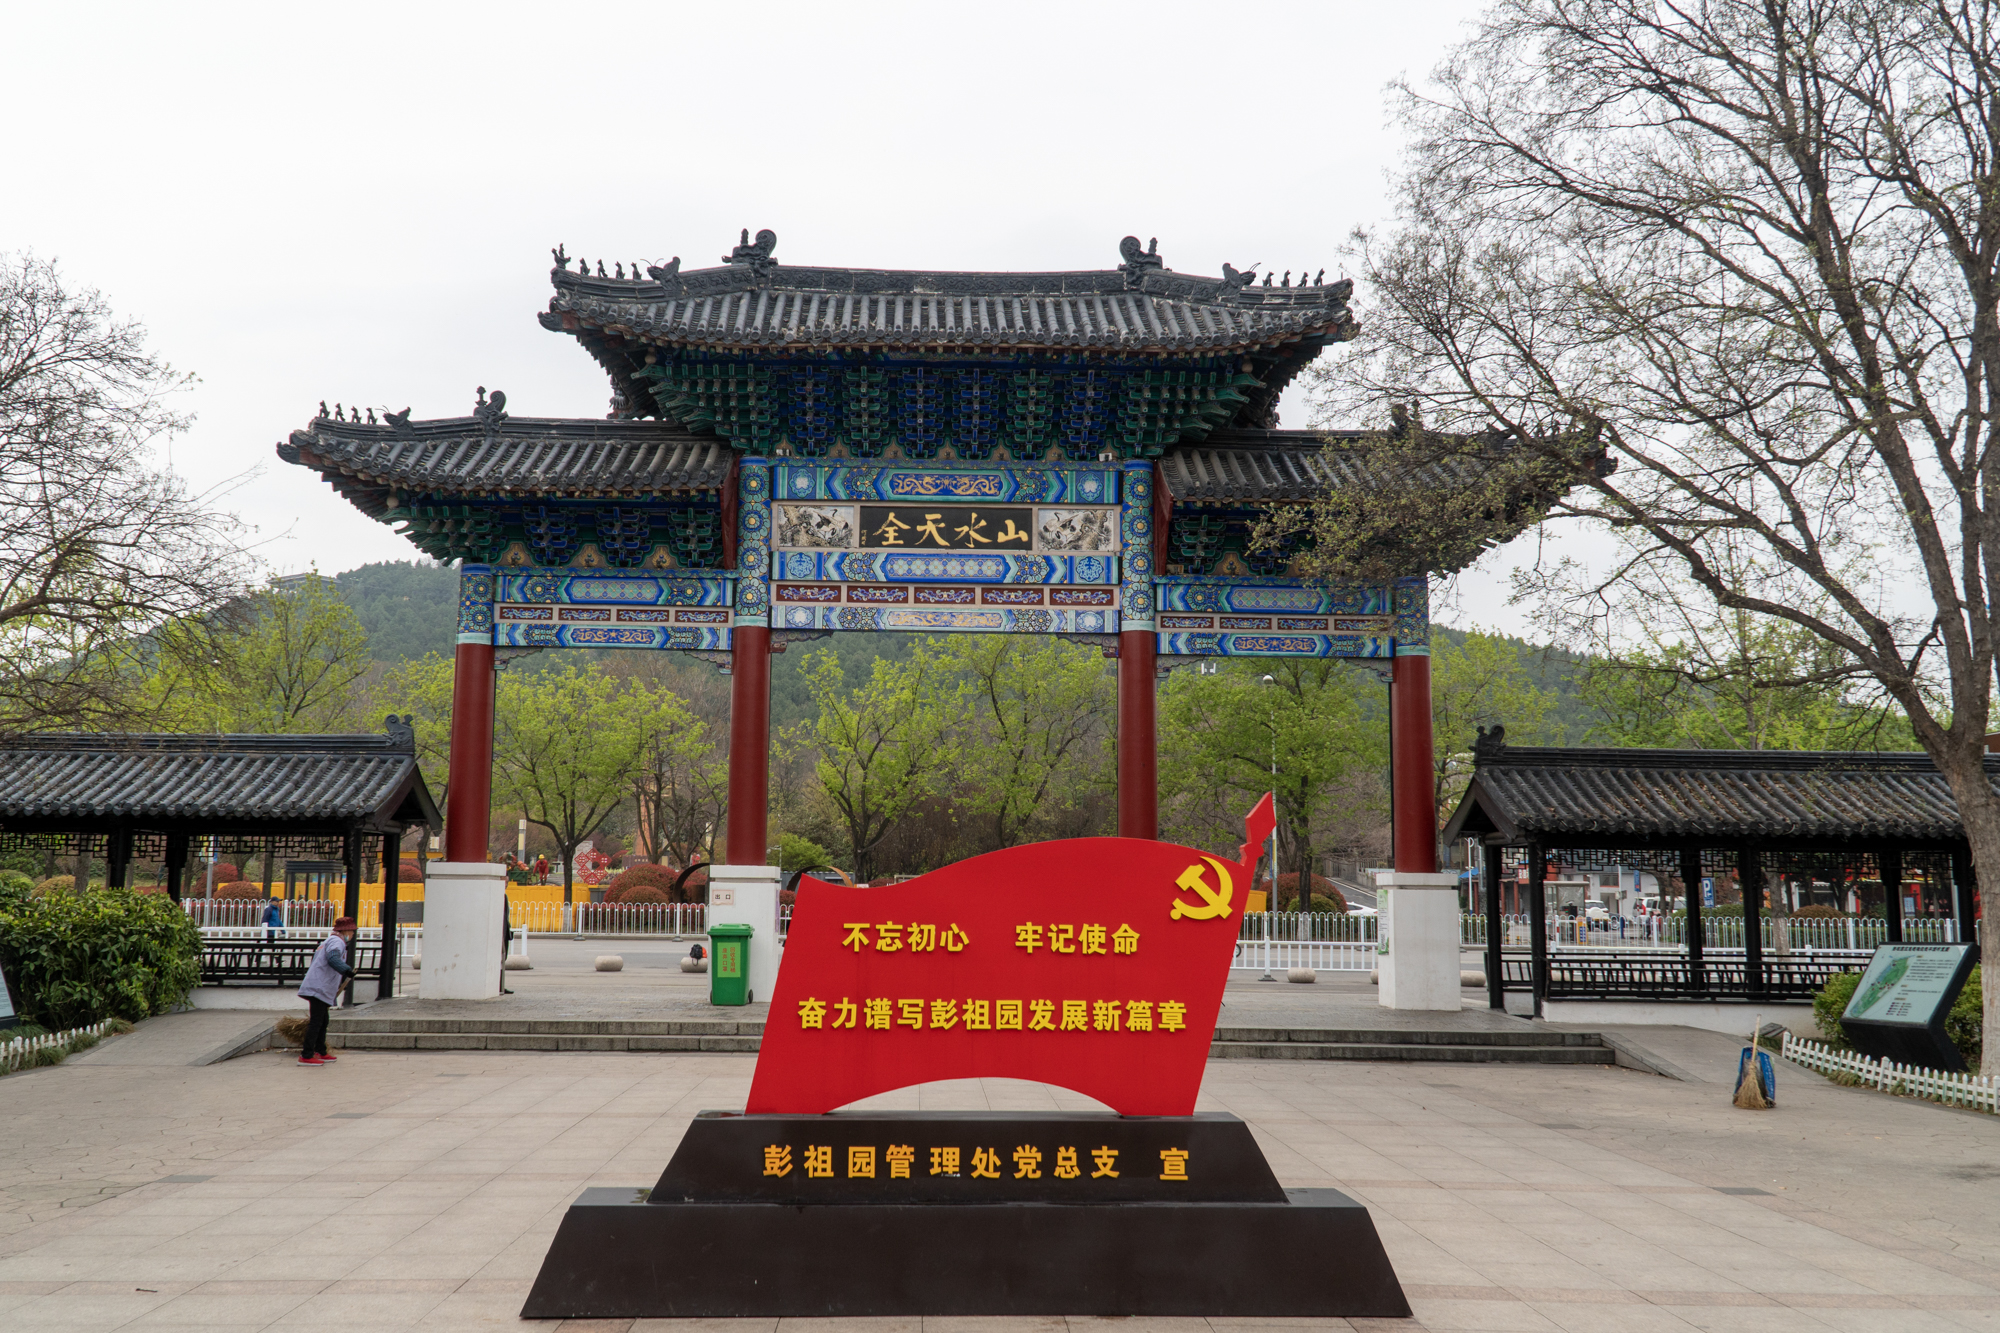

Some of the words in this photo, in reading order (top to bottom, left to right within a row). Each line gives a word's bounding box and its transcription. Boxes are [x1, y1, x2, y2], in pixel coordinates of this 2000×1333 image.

[842, 921, 970, 953] 不忘初心
[1014, 922, 1141, 955] 牢记使命
[798, 997, 1187, 1033] 奋力谱写彭祖园发展新篇章
[763, 1144, 1120, 1179] 彭祖园管理处党总支
[1159, 1148, 1189, 1181] 宣
